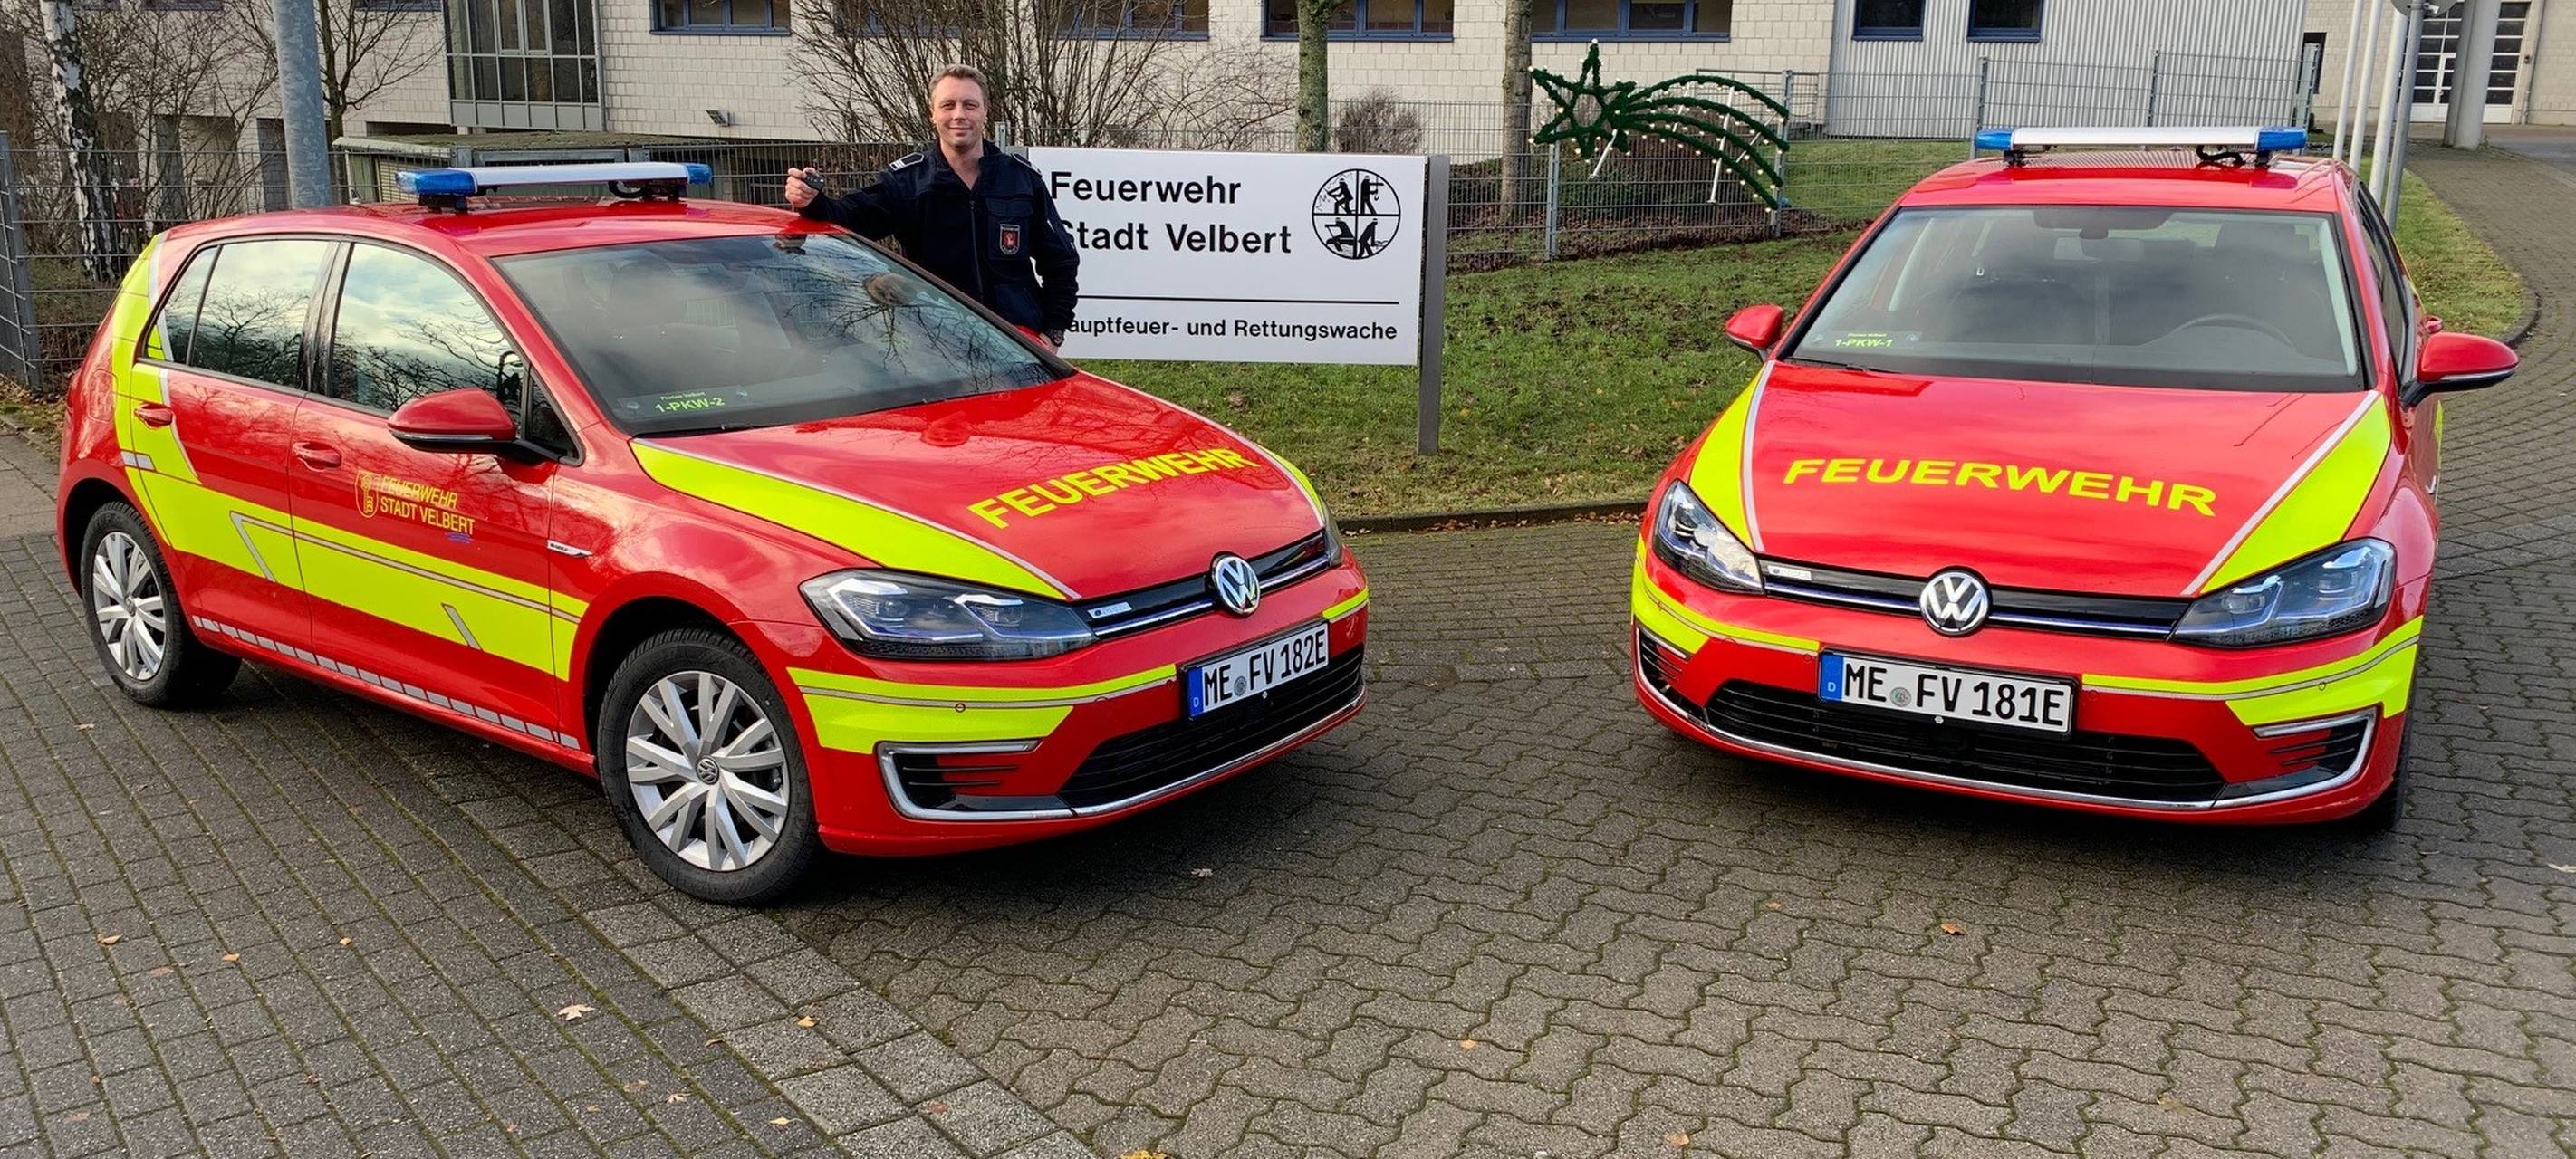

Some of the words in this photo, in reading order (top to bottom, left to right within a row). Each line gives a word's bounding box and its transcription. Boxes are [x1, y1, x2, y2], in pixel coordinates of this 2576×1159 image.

[1051, 171, 1241, 205] Feuerwehr
[1166, 223, 1292, 254] Velbert
[1068, 316, 1179, 337] auptfeuer-
[1187, 319, 1226, 338] und
[1235, 320, 1398, 341] Rettungswache
[1835, 338, 1894, 348] 1-PKW-1
[655, 397, 725, 413] 1-PKW-2
[381, 475, 458, 509] FEUERWEHR
[968, 448, 1261, 528] FEUERWEHR
[1783, 458, 2216, 516] FEUERWEHR
[380, 495, 417, 520] STADT
[419, 505, 476, 535] VELBERT
[1204, 664, 1233, 706] ME
[1249, 648, 1274, 691] FV
[1280, 629, 1326, 679] 182E
[1827, 682, 1837, 693] D
[1844, 663, 1888, 703] ME
[1916, 673, 1962, 713] FV
[1972, 681, 2065, 726] 181E
